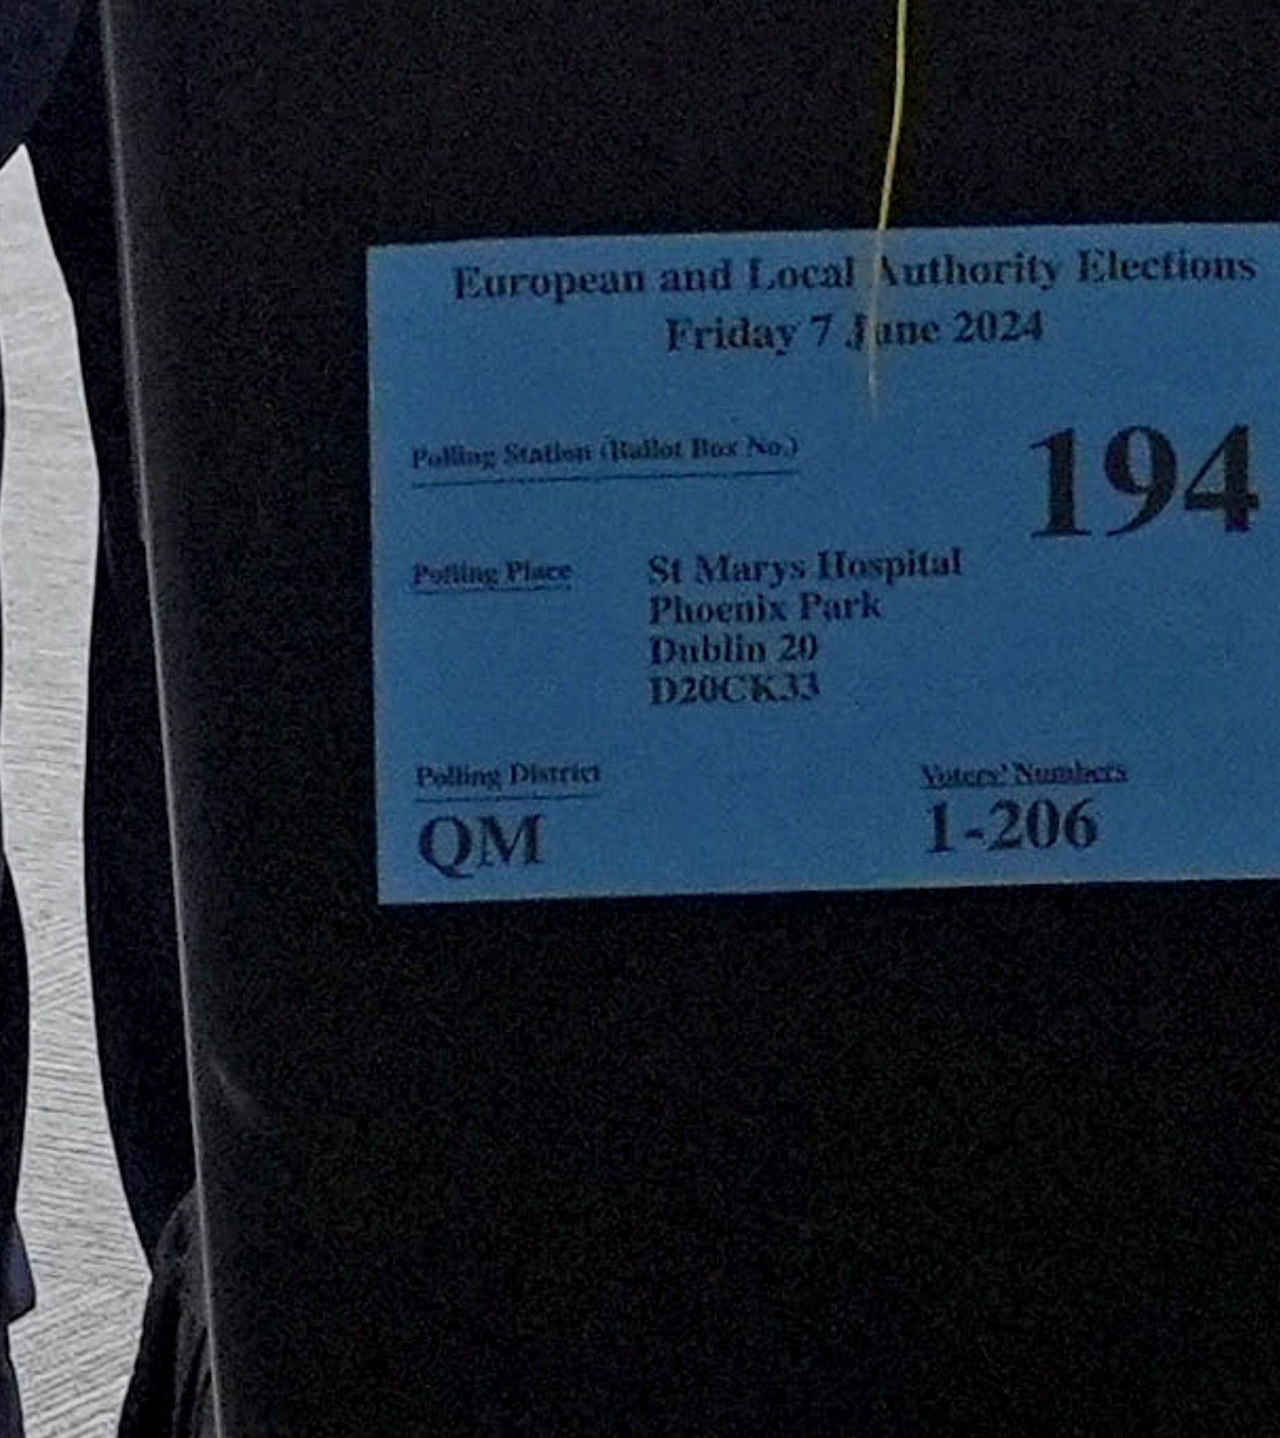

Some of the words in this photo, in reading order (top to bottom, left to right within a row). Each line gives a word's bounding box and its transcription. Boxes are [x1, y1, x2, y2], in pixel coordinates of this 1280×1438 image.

[453, 266, 643, 304] European
[660, 258, 731, 291] and
[749, 255, 854, 291] Local
[876, 252, 1057, 292] Authority
[1078, 247, 1257, 283] Elections
[666, 317, 797, 356] Friday
[811, 312, 832, 347] 7
[845, 313, 940, 351] June
[953, 308, 1045, 344] 2024
[412, 445, 496, 471] Polling
[503, 441, 592, 465] Station
[600, 435, 683, 462] (Ballot
[691, 437, 738, 460] Box
[746, 436, 799, 459] No.)
[1030, 424, 1261, 539] 194
[412, 562, 499, 588] Polling
[505, 560, 572, 584] Place
[648, 555, 683, 585] St
[694, 553, 806, 587] Marys
[818, 547, 963, 589] Hospital
[649, 593, 788, 625] Phoenix
[800, 590, 883, 622] Park
[650, 635, 767, 666] Dublin
[778, 632, 819, 662] 20
[650, 671, 821, 706] D20CK33
[416, 765, 502, 791] Polling
[509, 762, 602, 786] District
[1012, 759, 1128, 784] Numbers
[927, 796, 1100, 854] 1-206
[419, 811, 545, 879] QM
